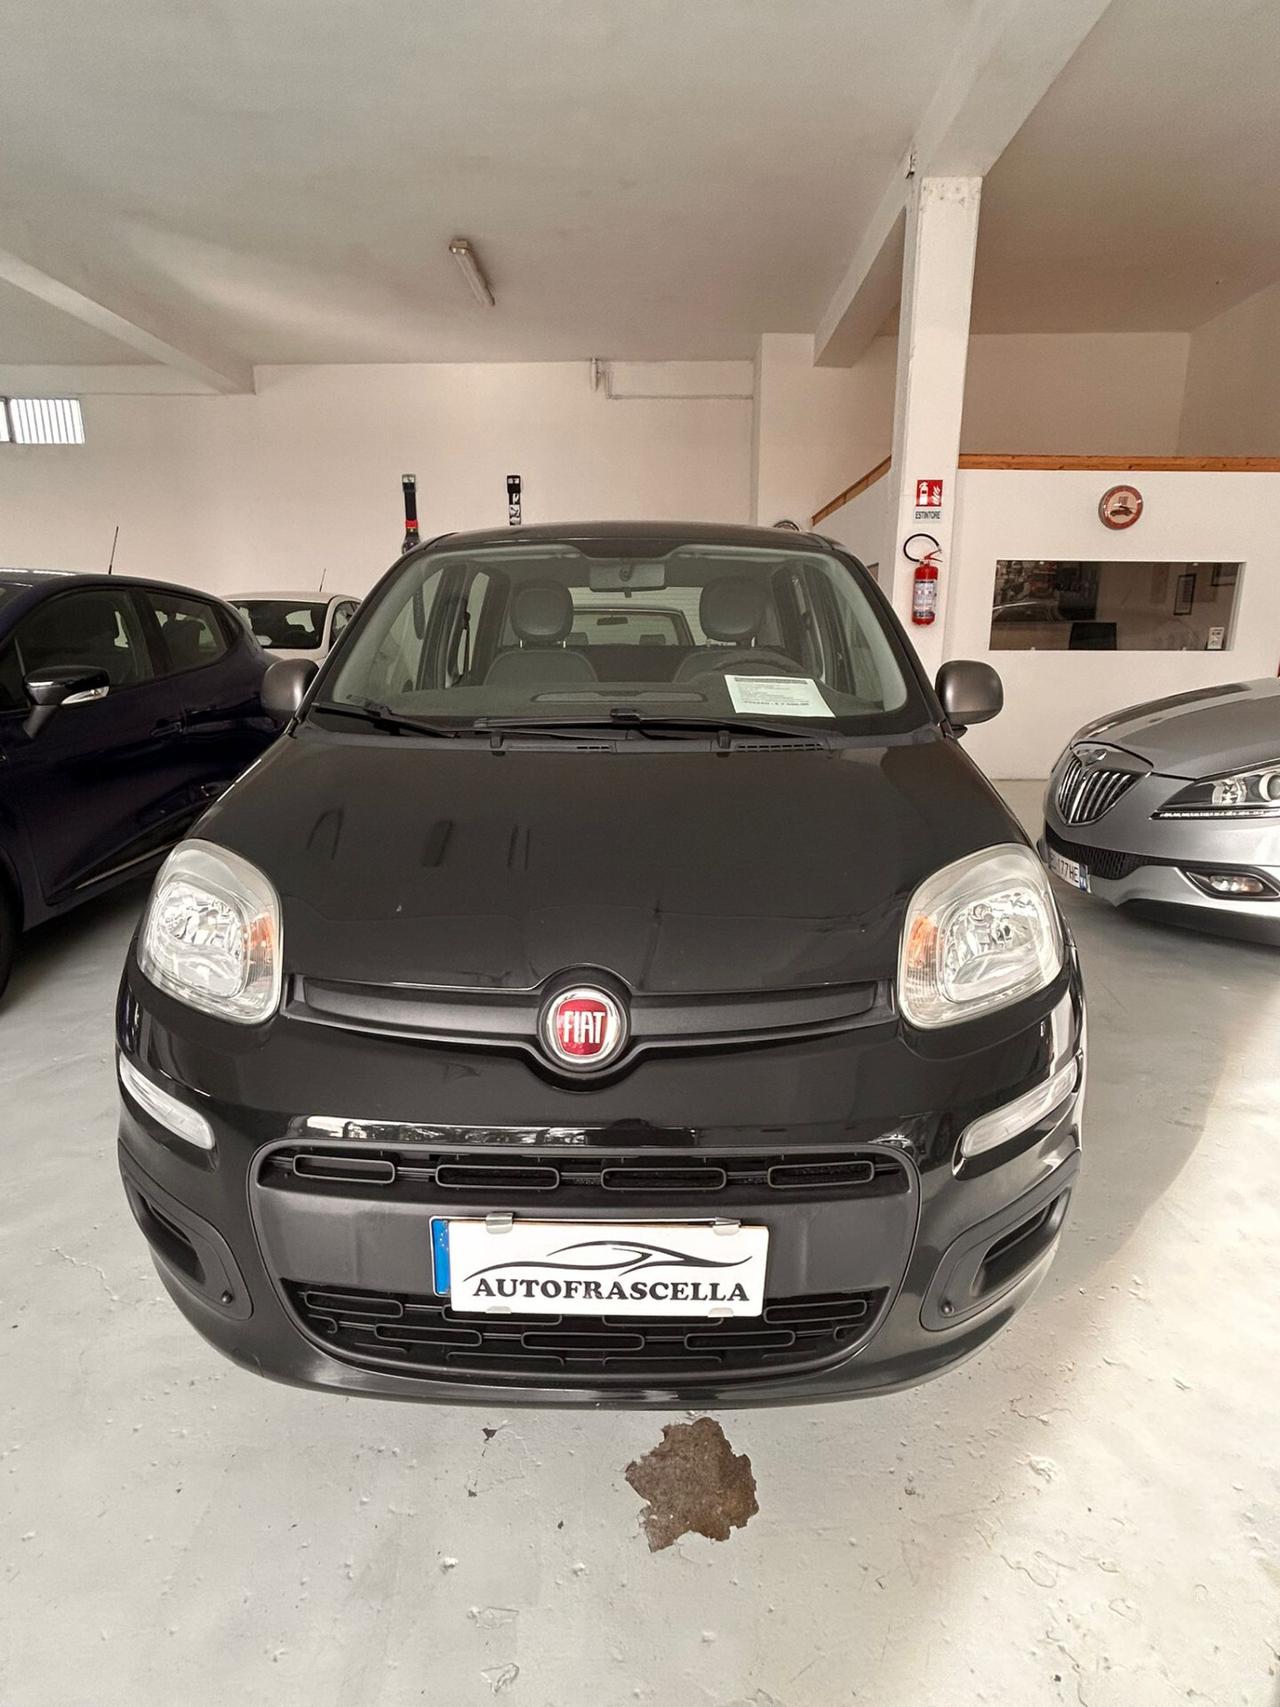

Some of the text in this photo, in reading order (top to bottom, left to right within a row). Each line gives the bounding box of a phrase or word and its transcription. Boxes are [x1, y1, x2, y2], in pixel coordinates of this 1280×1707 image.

[915, 511, 941, 520] ESTINTORE
[563, 1011, 606, 1044] FIAT
[472, 1278, 750, 1302] AUTOFRASCELLA
